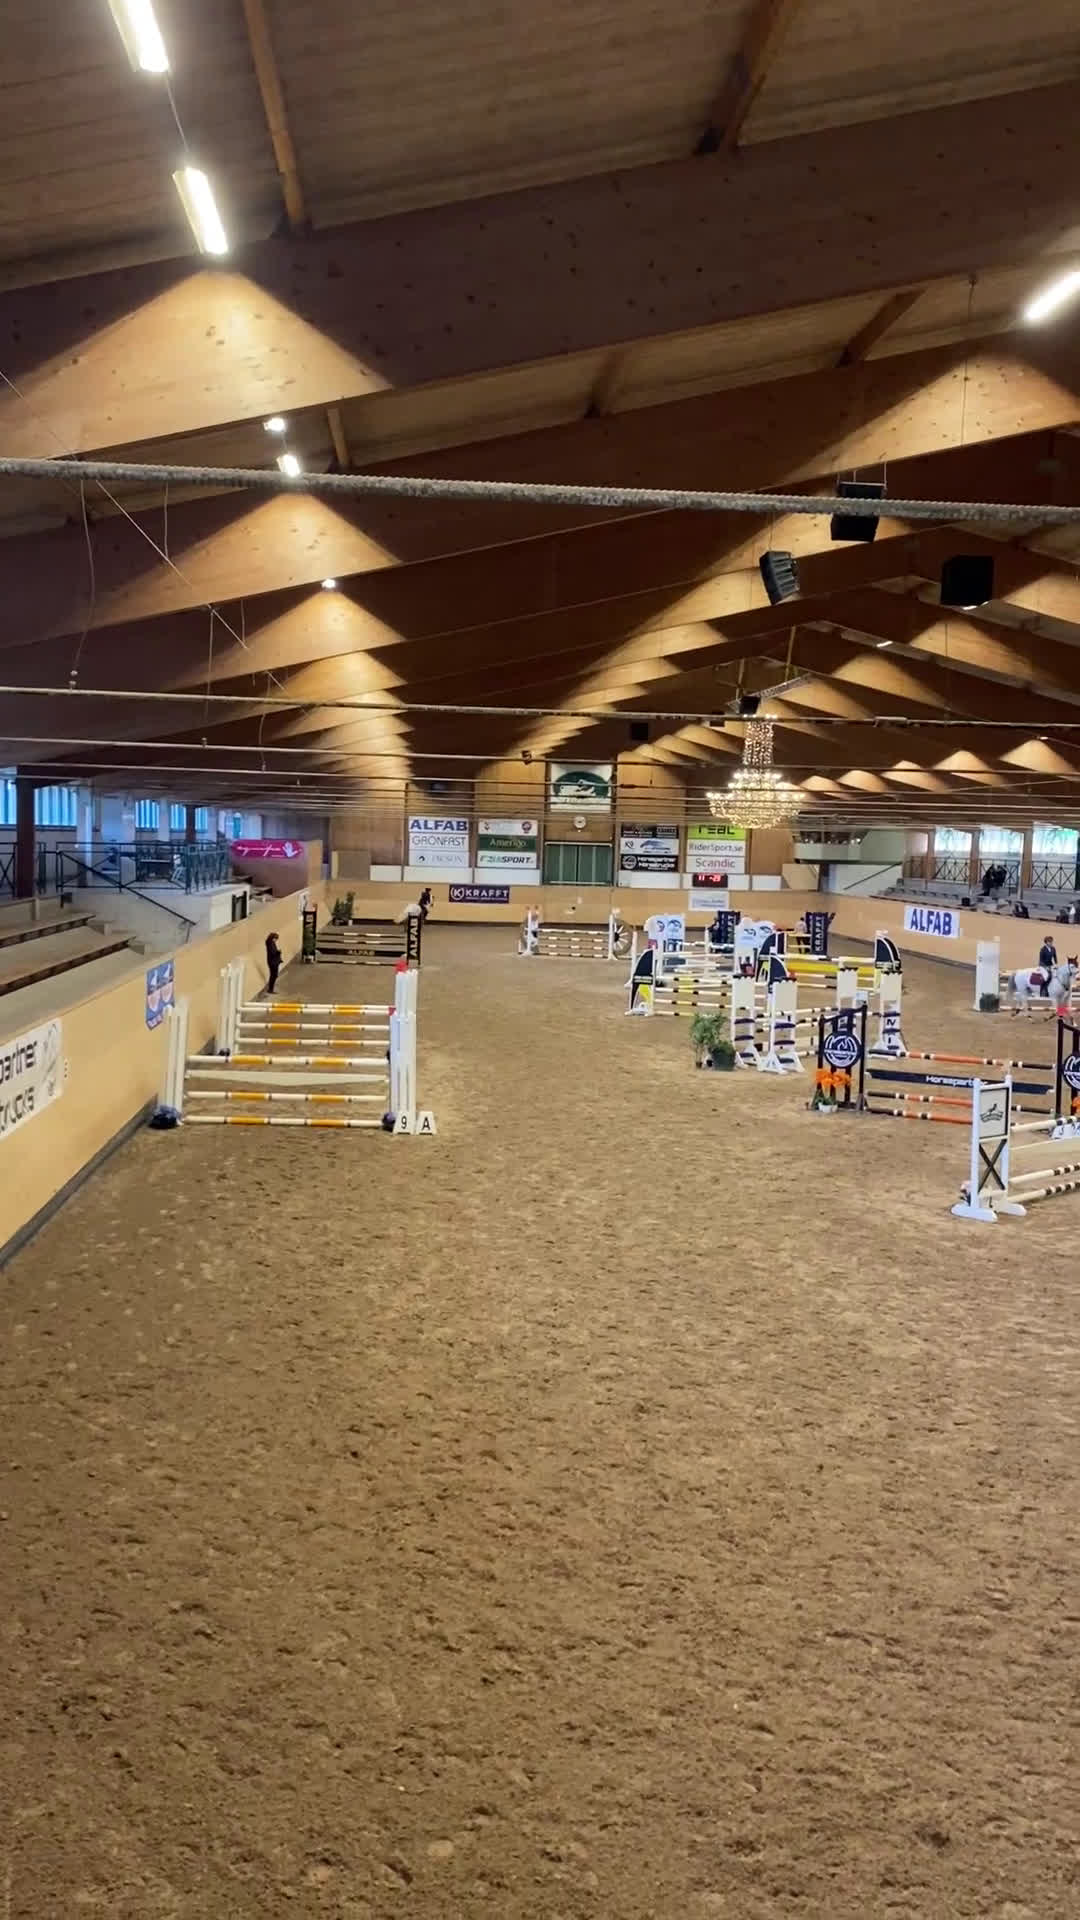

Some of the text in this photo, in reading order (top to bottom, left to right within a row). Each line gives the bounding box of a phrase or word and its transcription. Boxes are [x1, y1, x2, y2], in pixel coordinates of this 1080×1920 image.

[410, 819, 468, 831] ALFAB
[695, 857, 736, 868] Scandic
[465, 889, 509, 897] KRAFFT
[910, 908, 952, 936] ALFAB
[409, 918, 418, 958] ALFAB
[401, 1115, 407, 1130] 9
[422, 1116, 431, 1131] A
